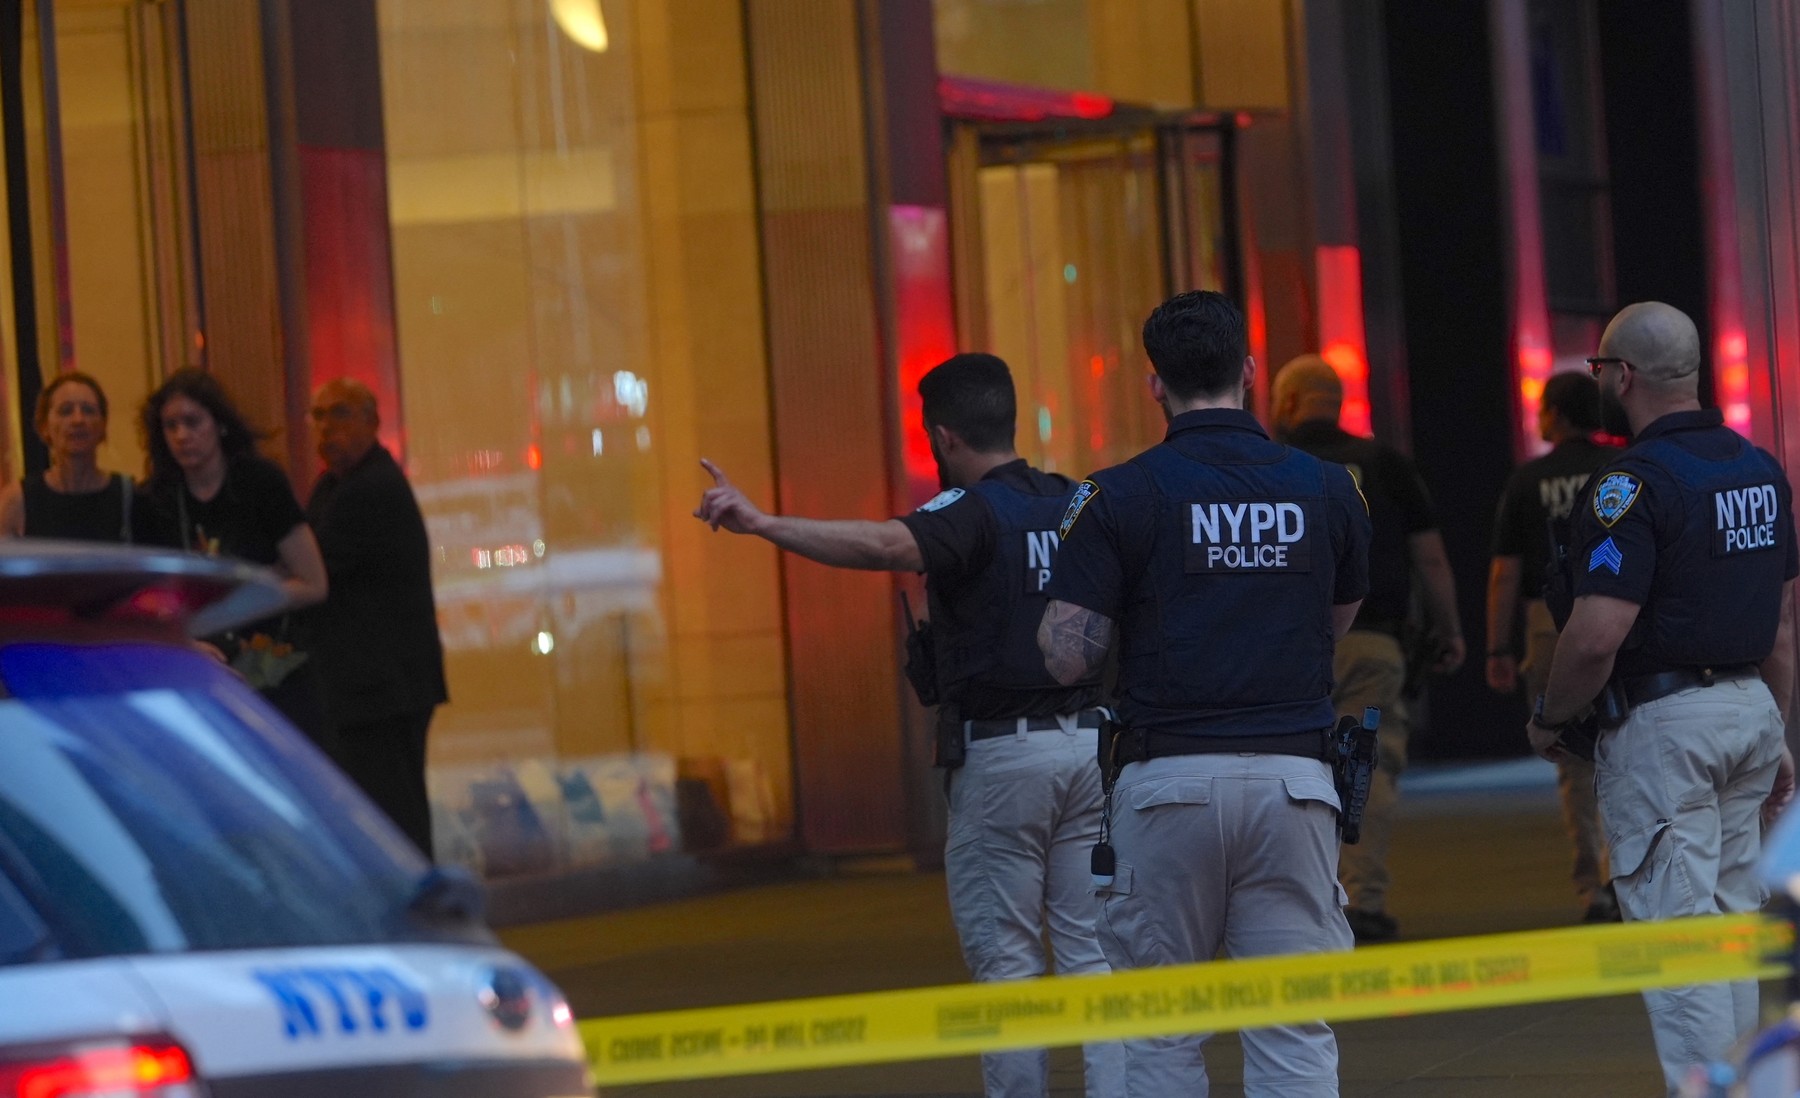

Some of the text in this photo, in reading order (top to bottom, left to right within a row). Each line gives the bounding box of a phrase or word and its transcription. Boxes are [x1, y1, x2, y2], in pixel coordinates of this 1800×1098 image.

[1191, 503, 1305, 544] NYPD
[1715, 484, 1778, 530] NYPD
[1207, 544, 1288, 568] POLICE
[1726, 523, 1775, 552] POLICE
[254, 967, 427, 1039] NYPD
